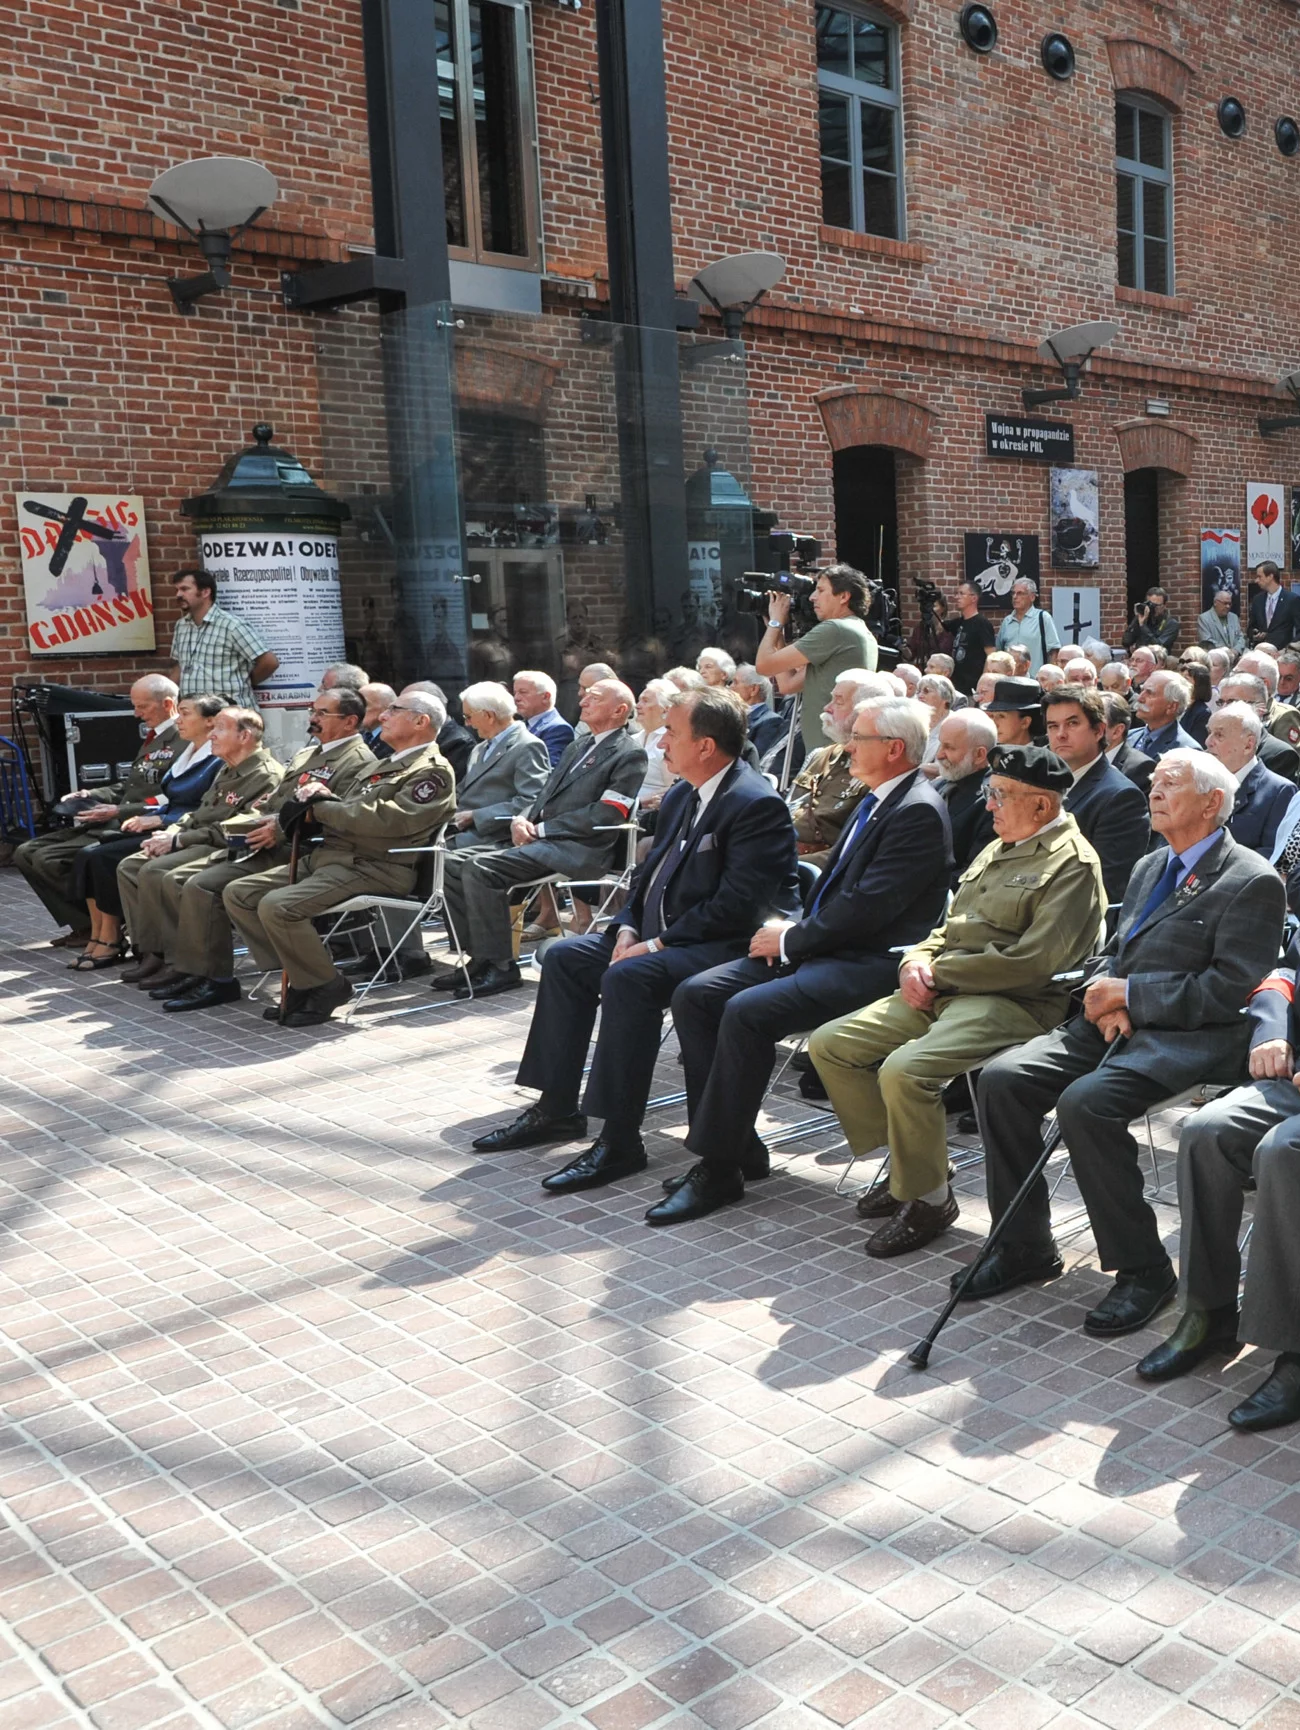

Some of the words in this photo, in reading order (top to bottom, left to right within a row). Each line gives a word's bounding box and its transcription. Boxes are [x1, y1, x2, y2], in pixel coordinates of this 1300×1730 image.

[991, 421, 1014, 436] Wojna
[1015, 426, 1021, 436] w
[1023, 428, 1070, 441] propagandzie
[992, 440, 998, 449] w
[1000, 438, 1028, 452] okresie
[1030, 441, 1044, 453] PRL
[203, 540, 294, 558] ODEZWA!
[29, 588, 154, 649] GDAŃSK
